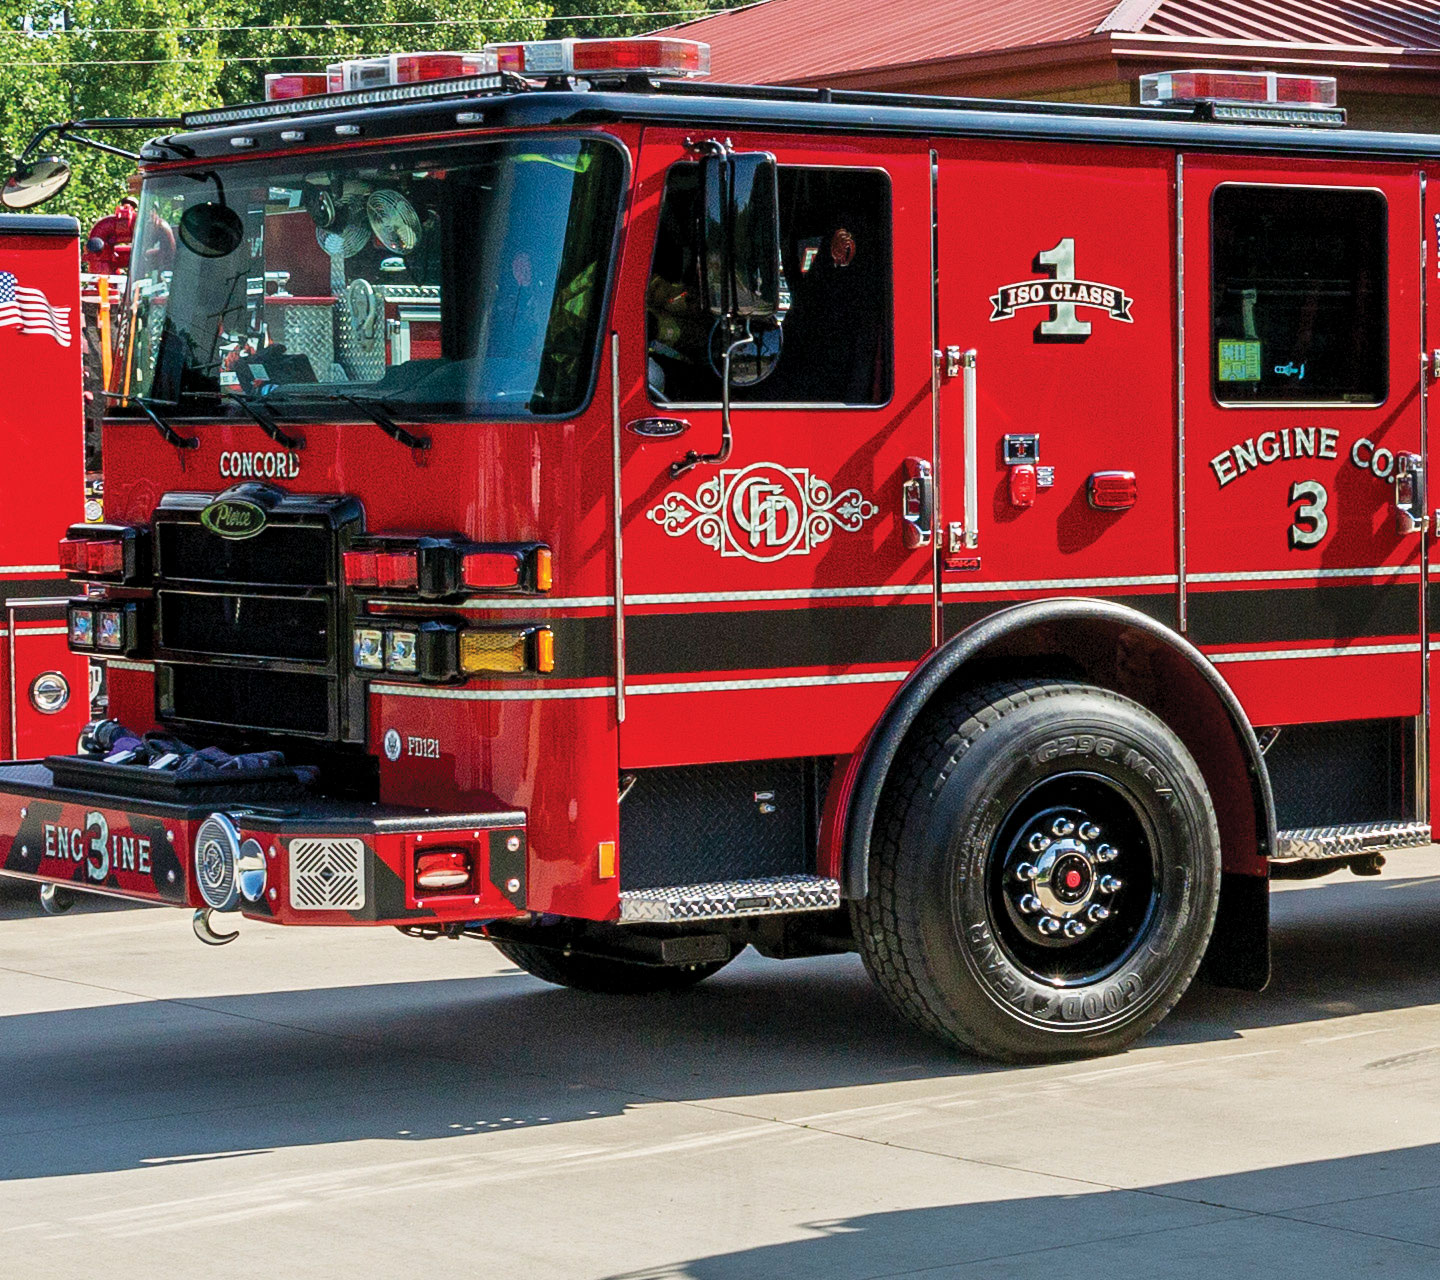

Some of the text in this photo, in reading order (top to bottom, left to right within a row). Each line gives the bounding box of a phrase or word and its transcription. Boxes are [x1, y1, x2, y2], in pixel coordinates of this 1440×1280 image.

[1007, 283, 1115, 307] ISO CLASS
[1040, 237, 1091, 334] 1
[220, 451, 300, 477] CONCORD
[1210, 427, 1395, 486] ENGINE CO.
[1292, 480, 1328, 544] 3
[408, 736, 440, 758] FD121
[1036, 734, 1116, 763] G296
